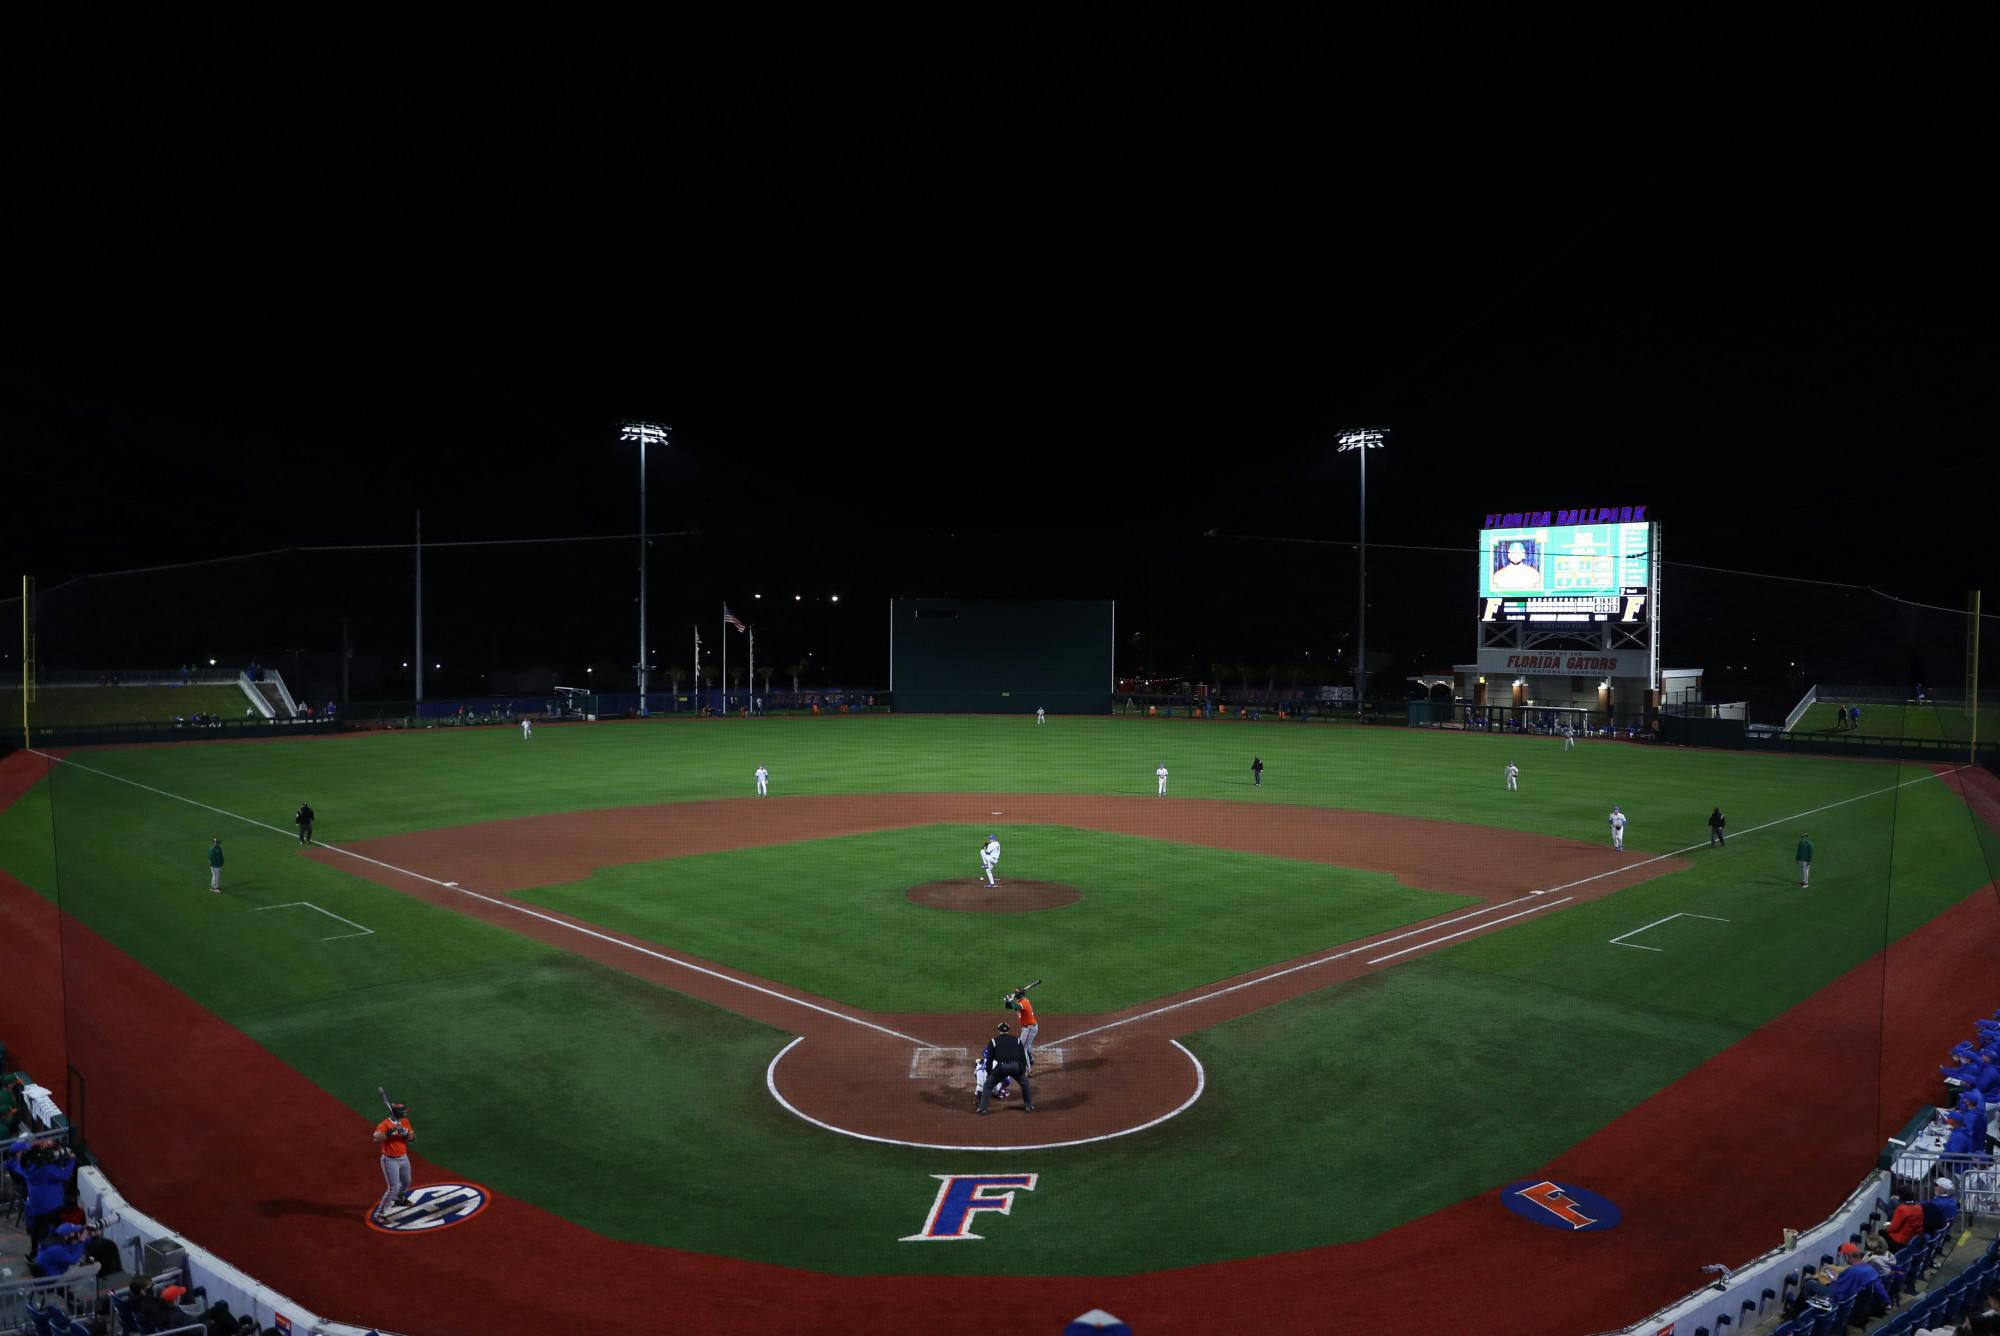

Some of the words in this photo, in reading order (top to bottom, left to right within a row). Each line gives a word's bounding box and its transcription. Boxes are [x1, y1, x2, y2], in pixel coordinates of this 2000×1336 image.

[1485, 511, 1551, 529] FLORIDA
[1556, 506, 1647, 526] BALLPARK
[1507, 655, 1560, 669] FLORIDA
[1566, 656, 1617, 670] GATORS
[898, 1173, 1039, 1242] F
